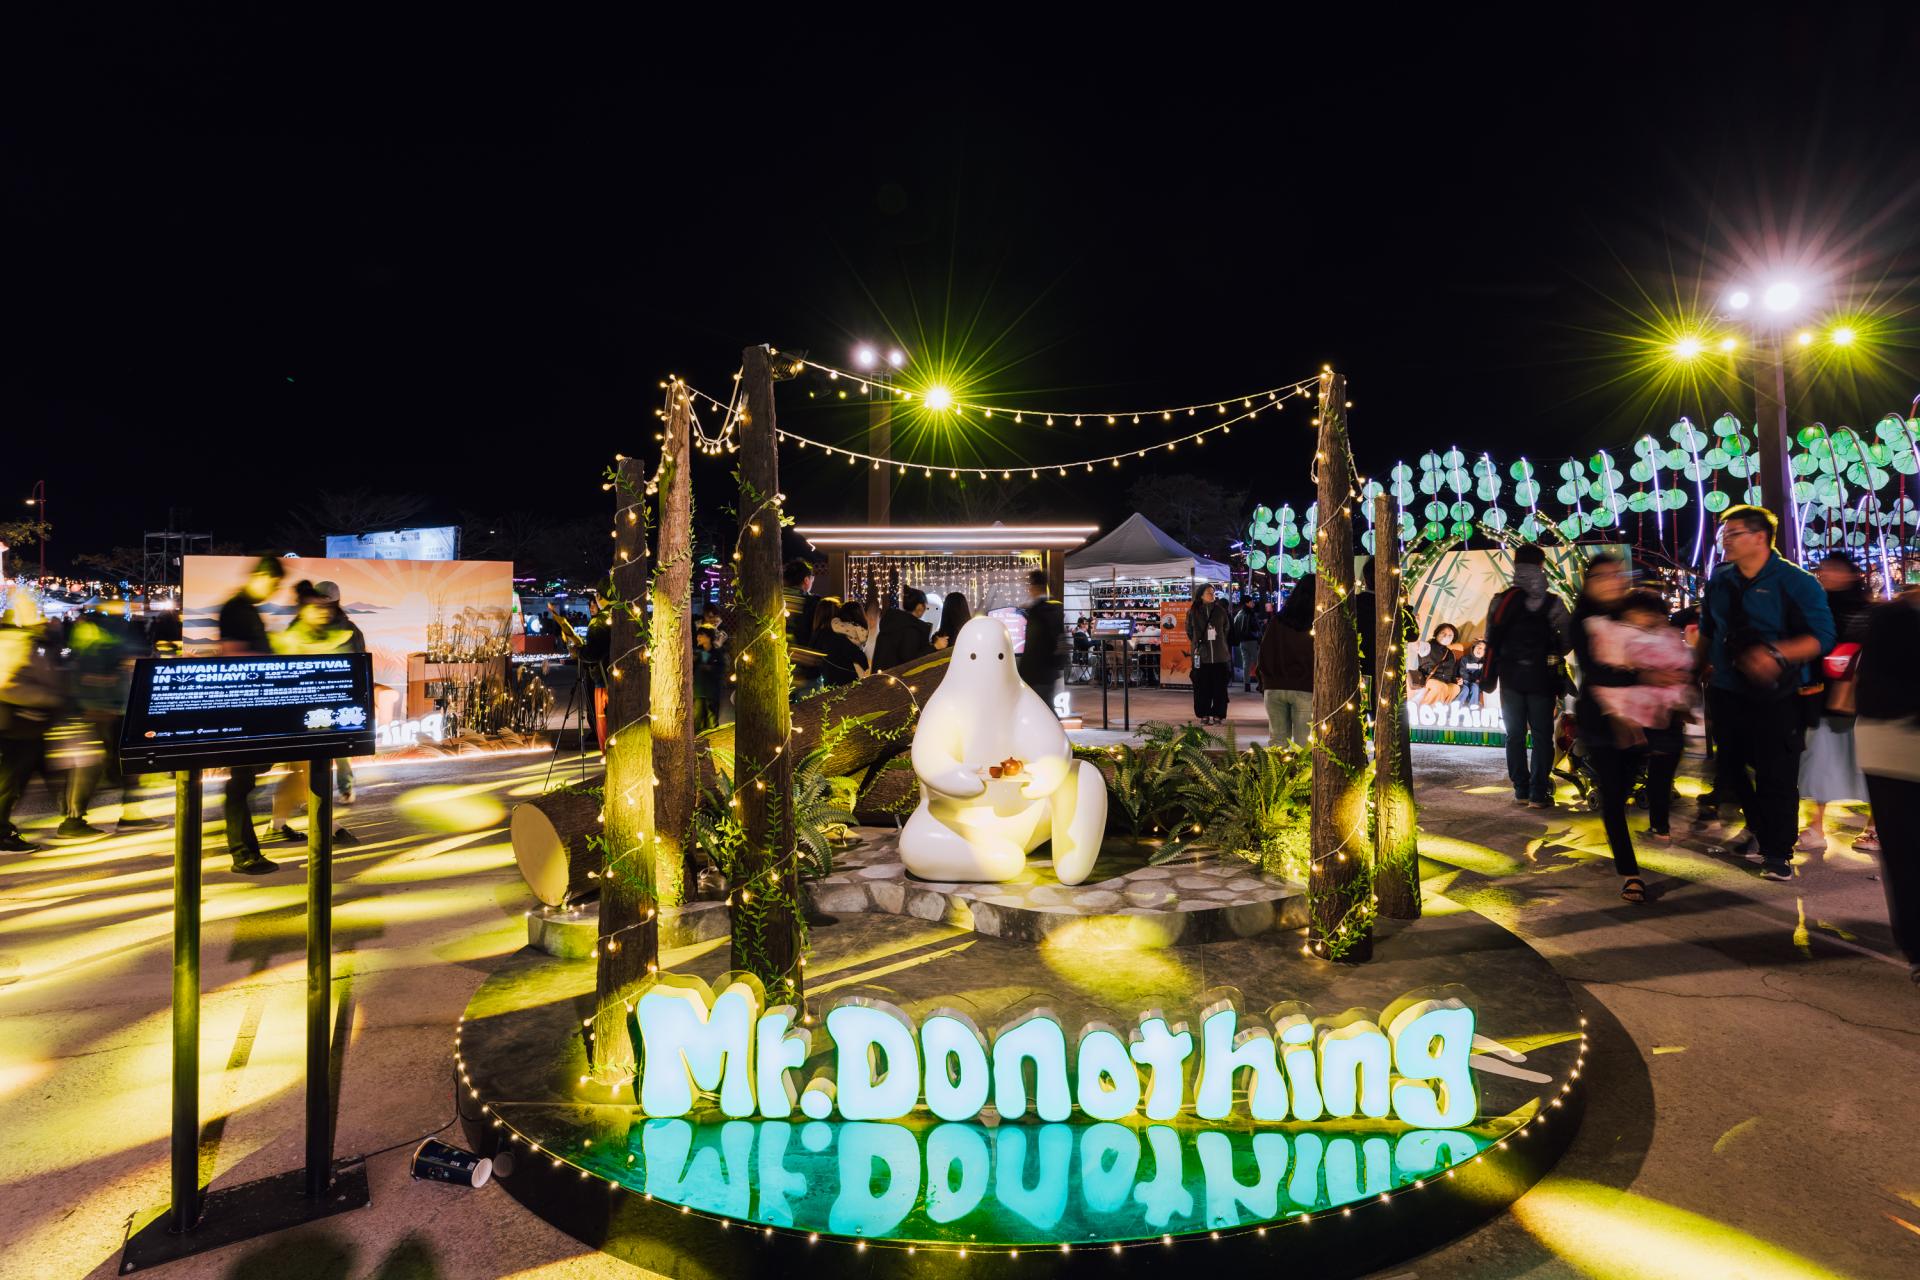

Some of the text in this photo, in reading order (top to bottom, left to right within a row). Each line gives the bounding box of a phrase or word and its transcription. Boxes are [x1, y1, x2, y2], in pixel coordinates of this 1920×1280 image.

[220, 662, 285, 673] LANTERN
[287, 660, 351, 670] FESTIVAL
[153, 672, 246, 684] IN CHIAYI
